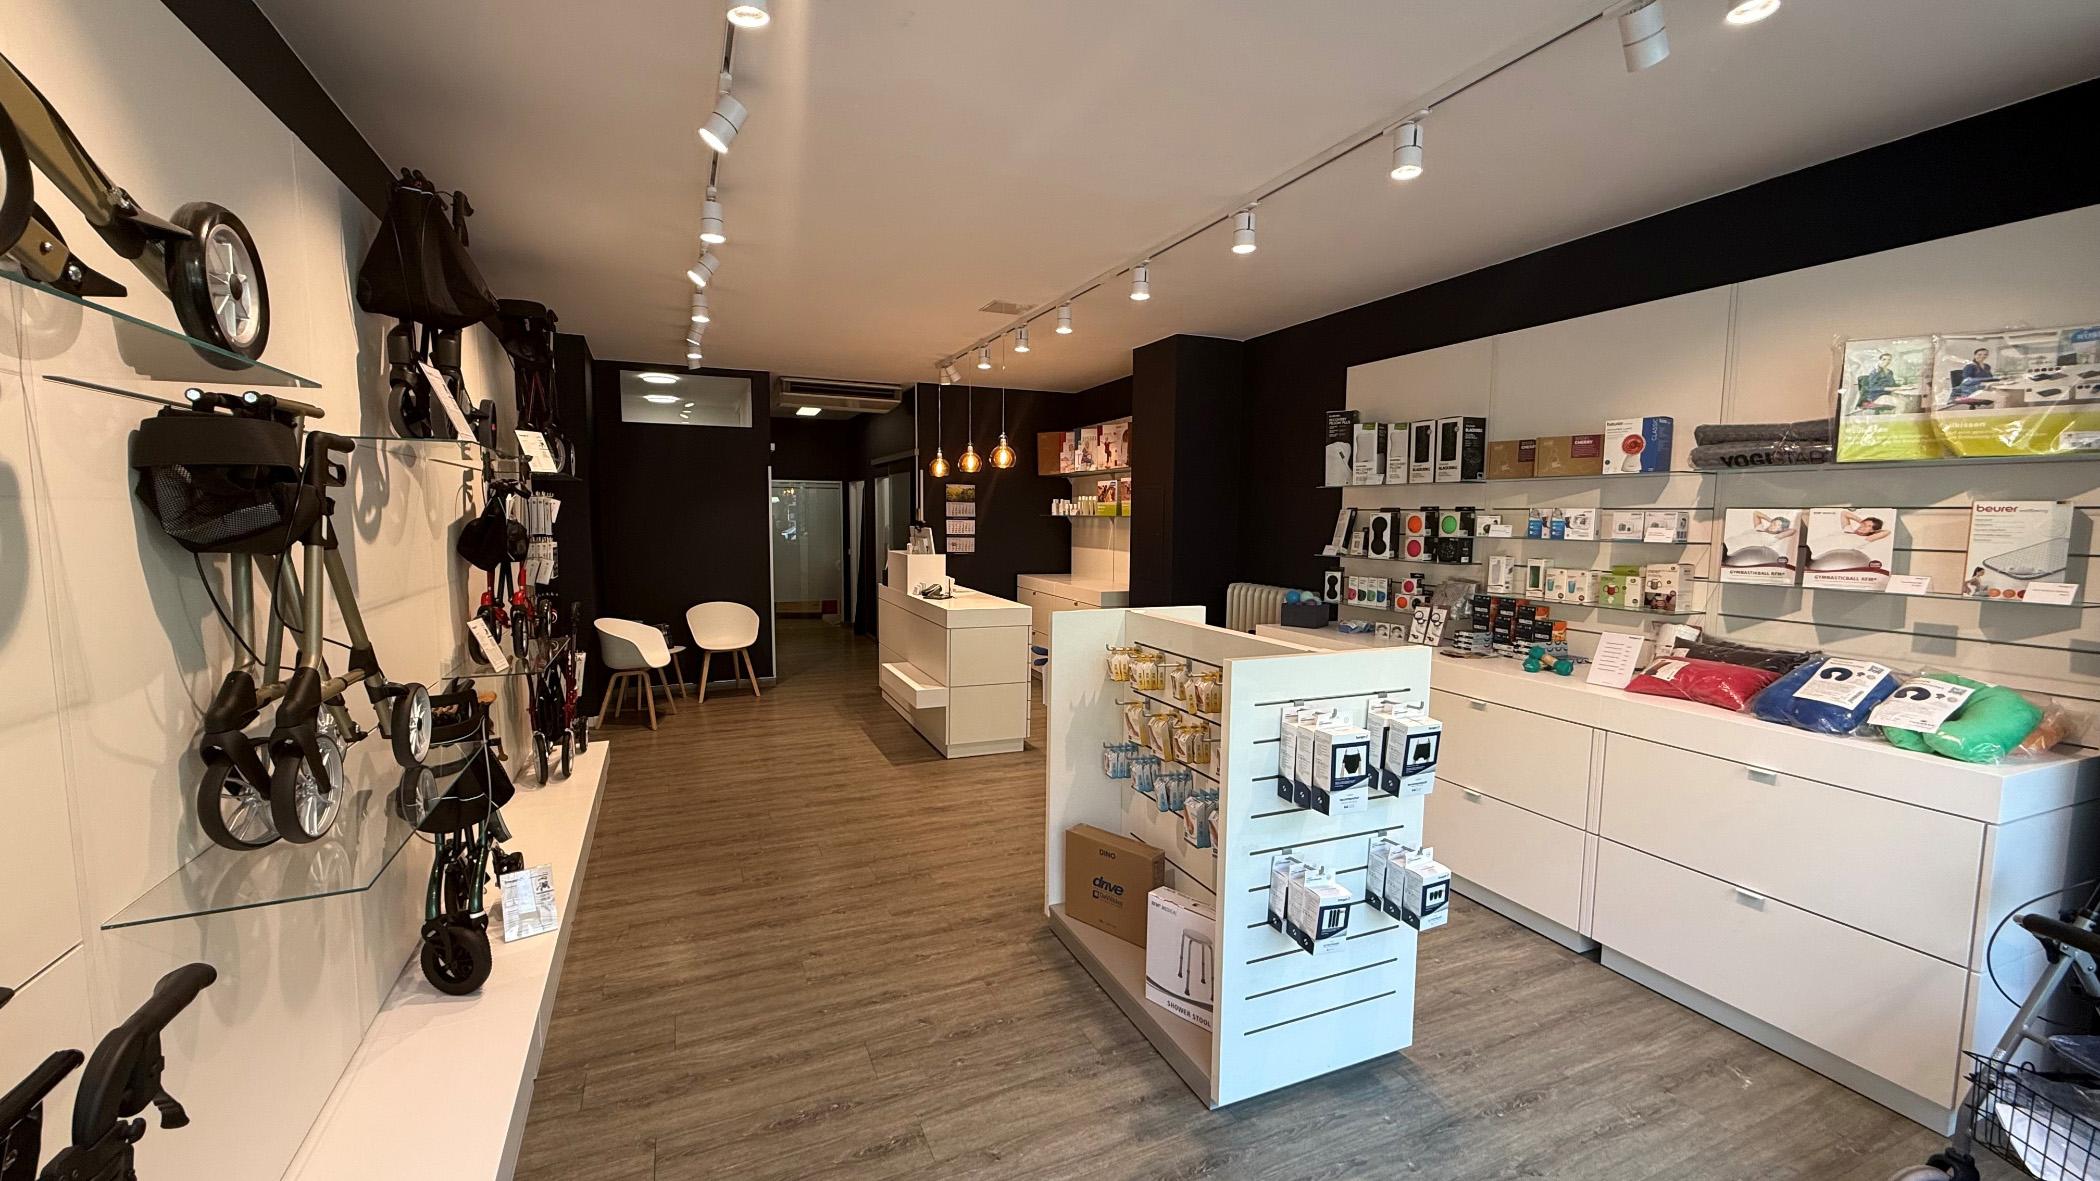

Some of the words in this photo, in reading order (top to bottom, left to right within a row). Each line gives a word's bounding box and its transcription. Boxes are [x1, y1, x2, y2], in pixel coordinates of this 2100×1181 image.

[1976, 504, 2018, 513] beurer
[1099, 848, 1116, 859] DINO
[1092, 876, 1124, 896] drive
[1167, 1000, 1191, 1018] SHOWER
[1192, 1013, 1211, 1028] STOOL
